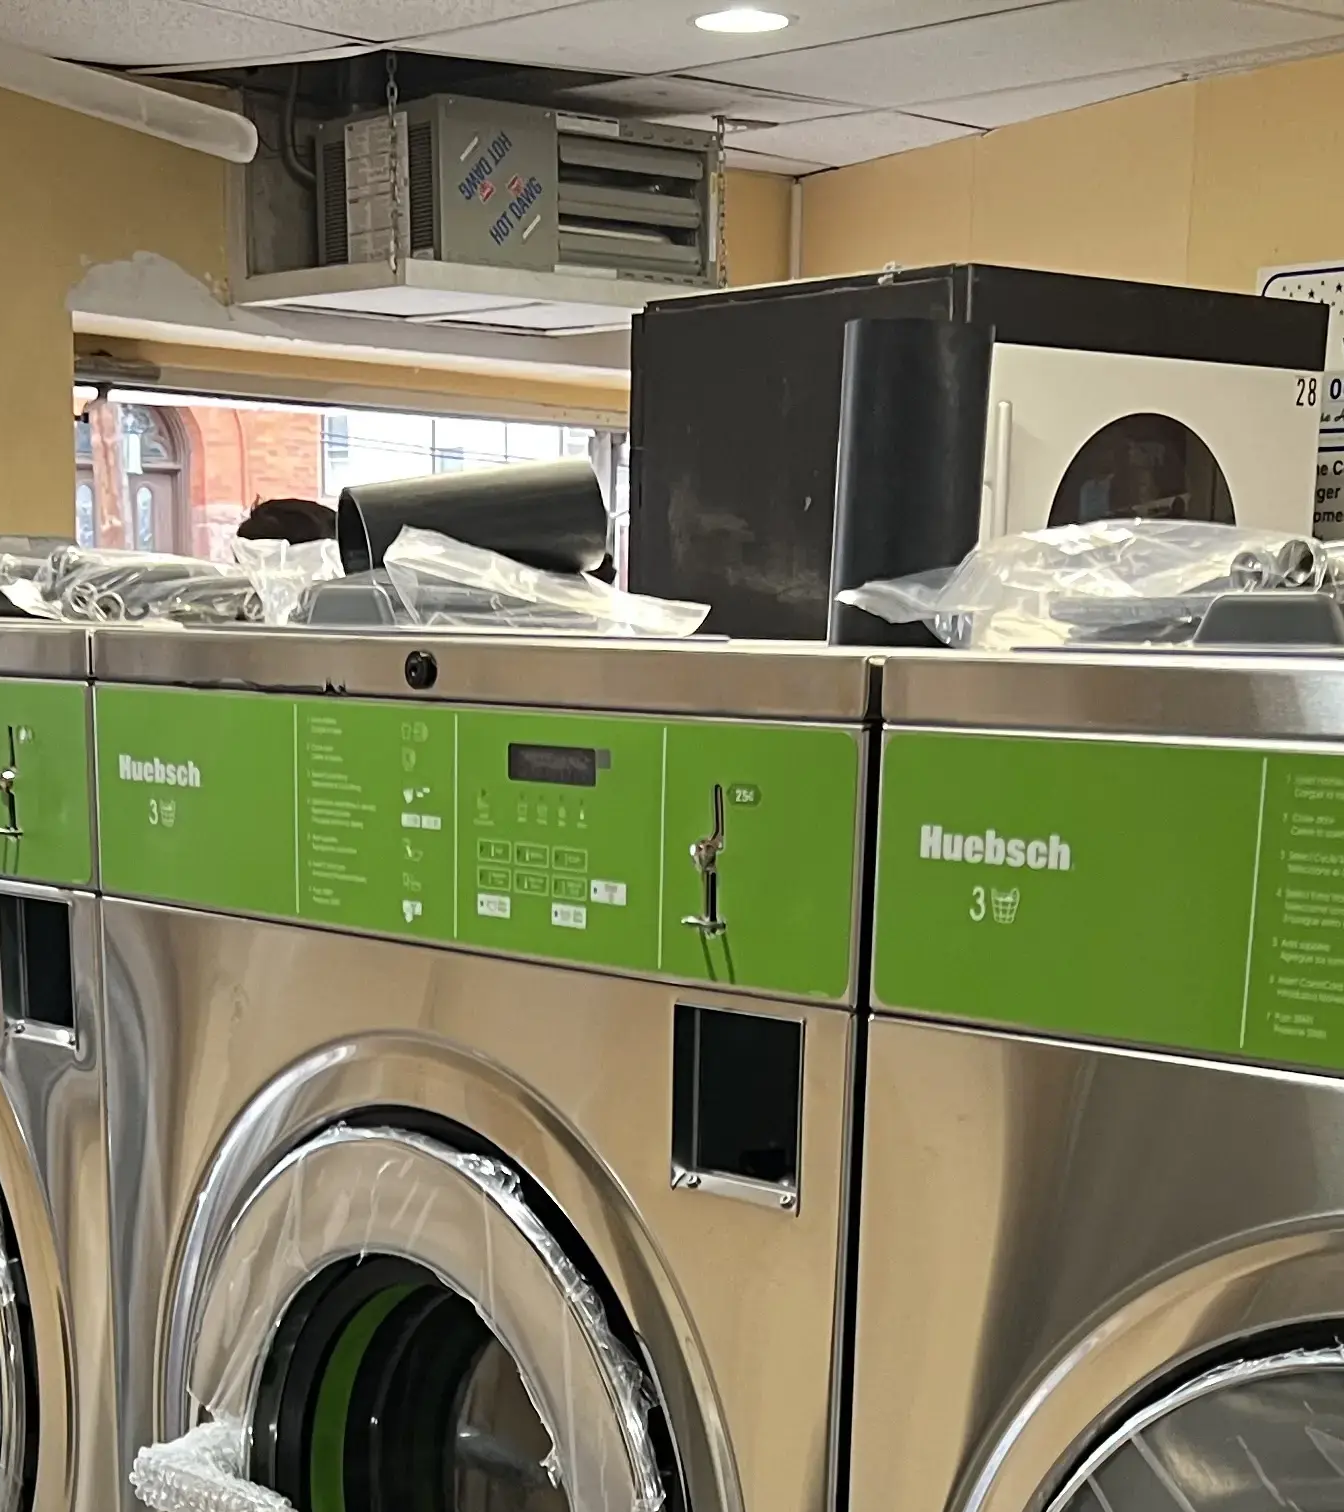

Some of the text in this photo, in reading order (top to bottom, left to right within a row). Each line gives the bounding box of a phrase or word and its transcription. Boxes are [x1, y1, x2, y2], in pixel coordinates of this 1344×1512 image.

[458, 131, 513, 200] HOT DAWG
[489, 177, 542, 246] HOT DAWG
[1295, 377, 1317, 407] 28
[1316, 487, 1340, 503] ger
[119, 754, 200, 787] Huebsch
[148, 799, 158, 824] 3
[920, 825, 1071, 871] Huebsch
[969, 885, 986, 921] 3
